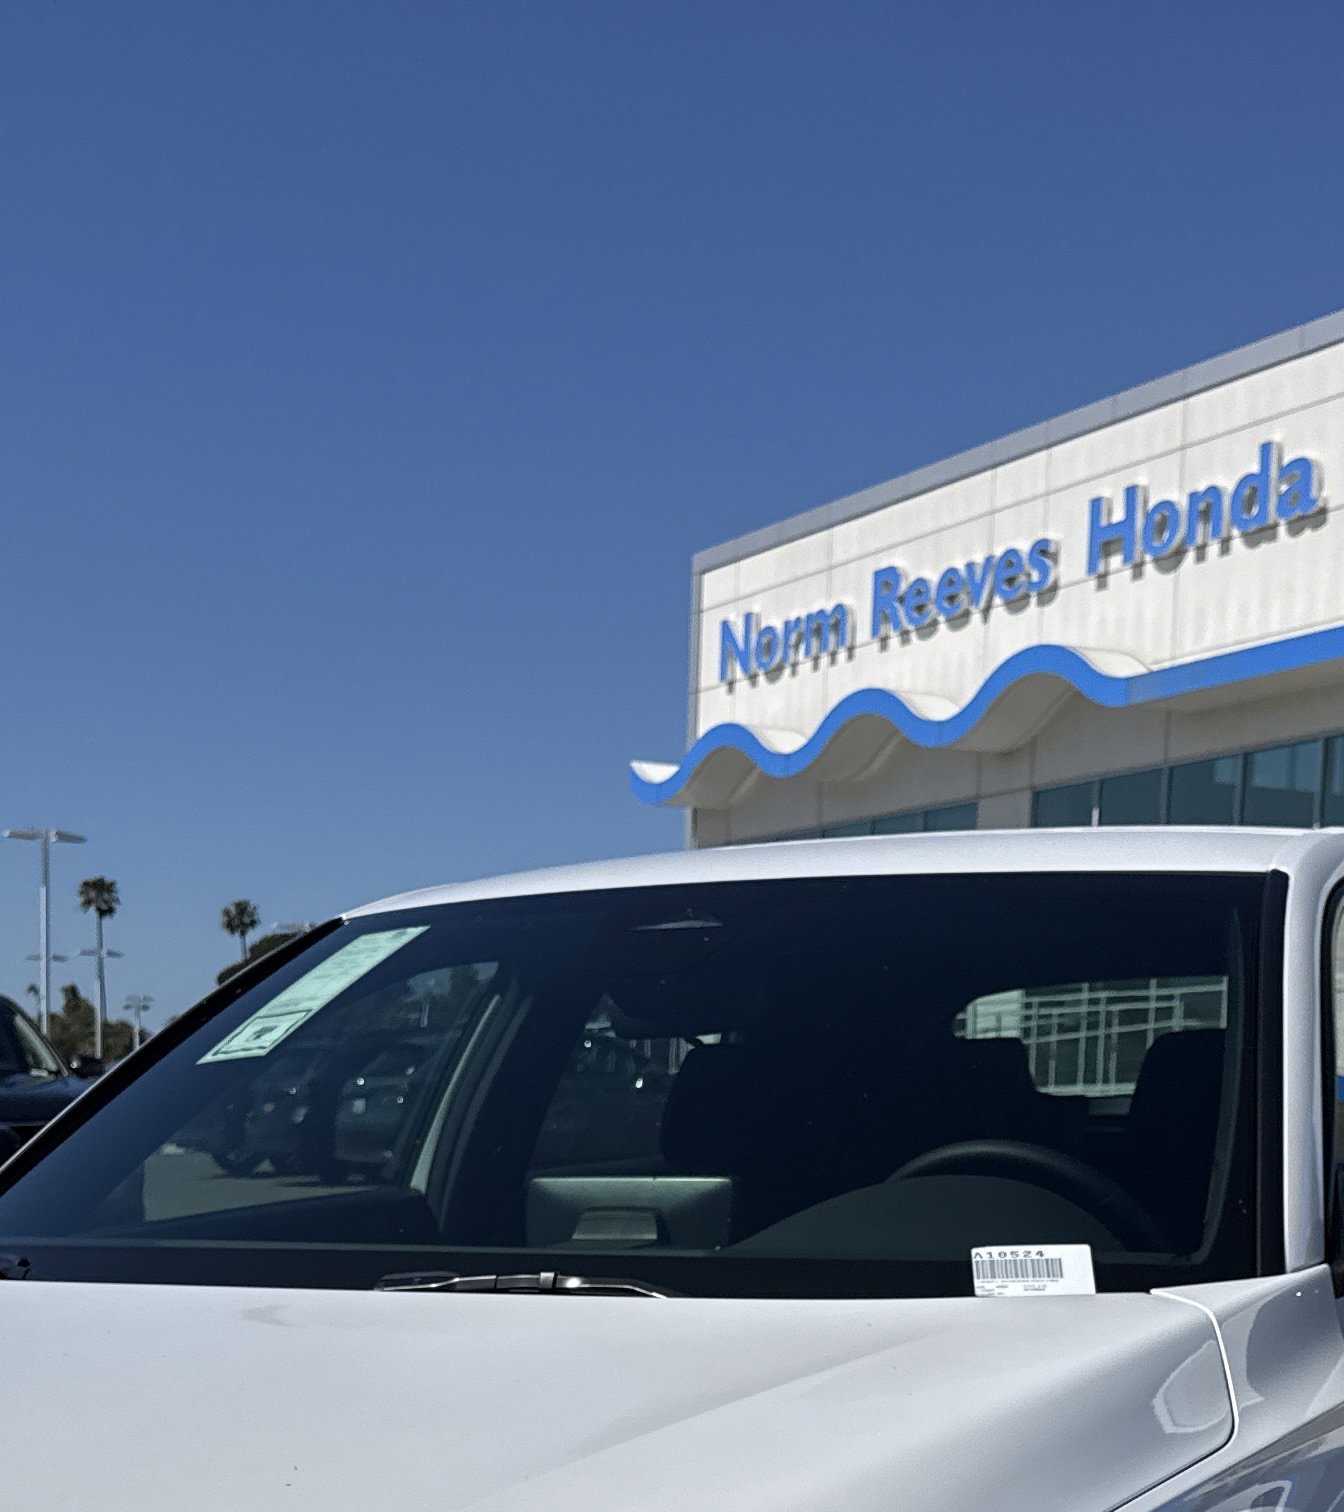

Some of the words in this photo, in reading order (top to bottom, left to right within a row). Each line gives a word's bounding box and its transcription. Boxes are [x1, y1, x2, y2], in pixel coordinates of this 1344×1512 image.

[719, 604, 848, 682] Norm
[871, 538, 1054, 639] Reeves
[1088, 442, 1318, 576] Honda
